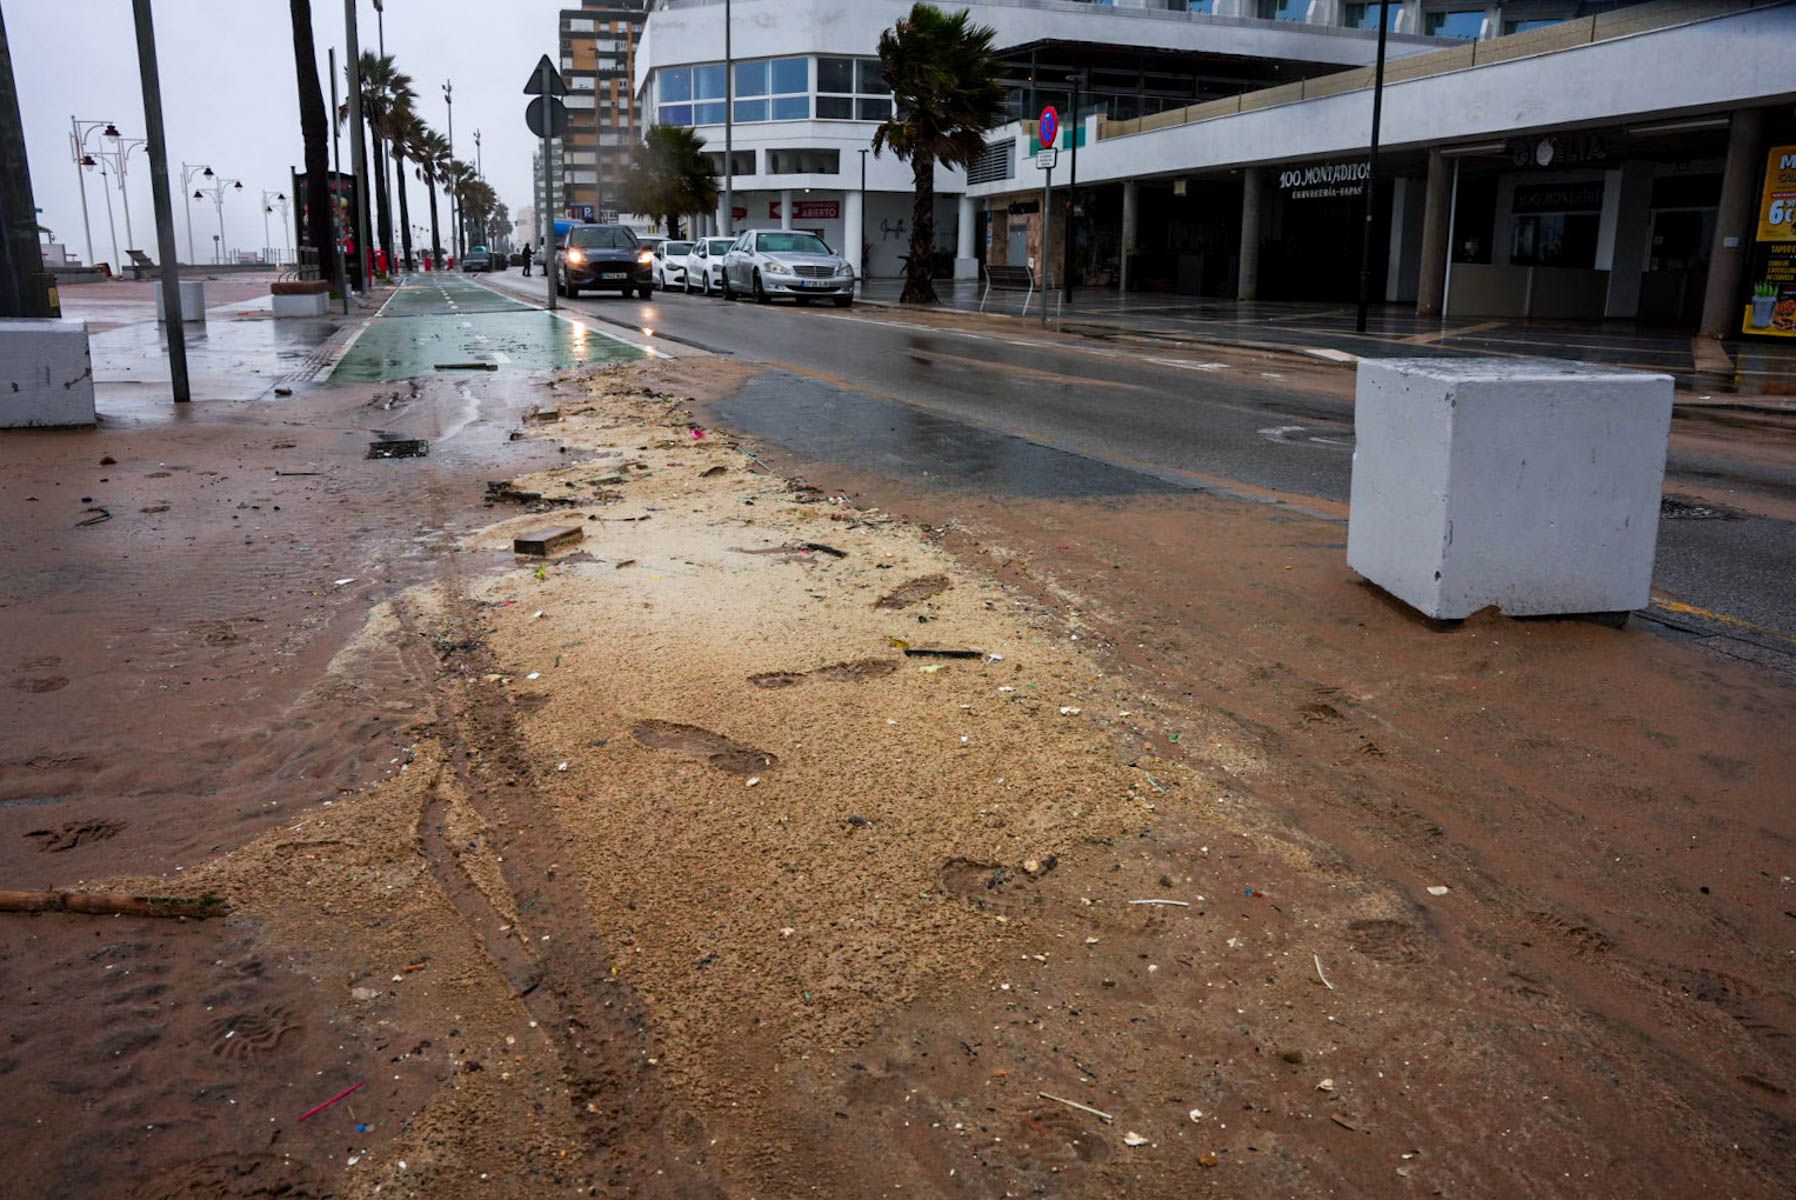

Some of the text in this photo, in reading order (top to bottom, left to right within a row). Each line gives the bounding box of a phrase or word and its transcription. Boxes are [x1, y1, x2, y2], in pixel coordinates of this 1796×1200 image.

[1280, 170, 1301, 188] 100
[584, 207, 593, 217] P
[802, 208, 836, 217] ABIERTO
